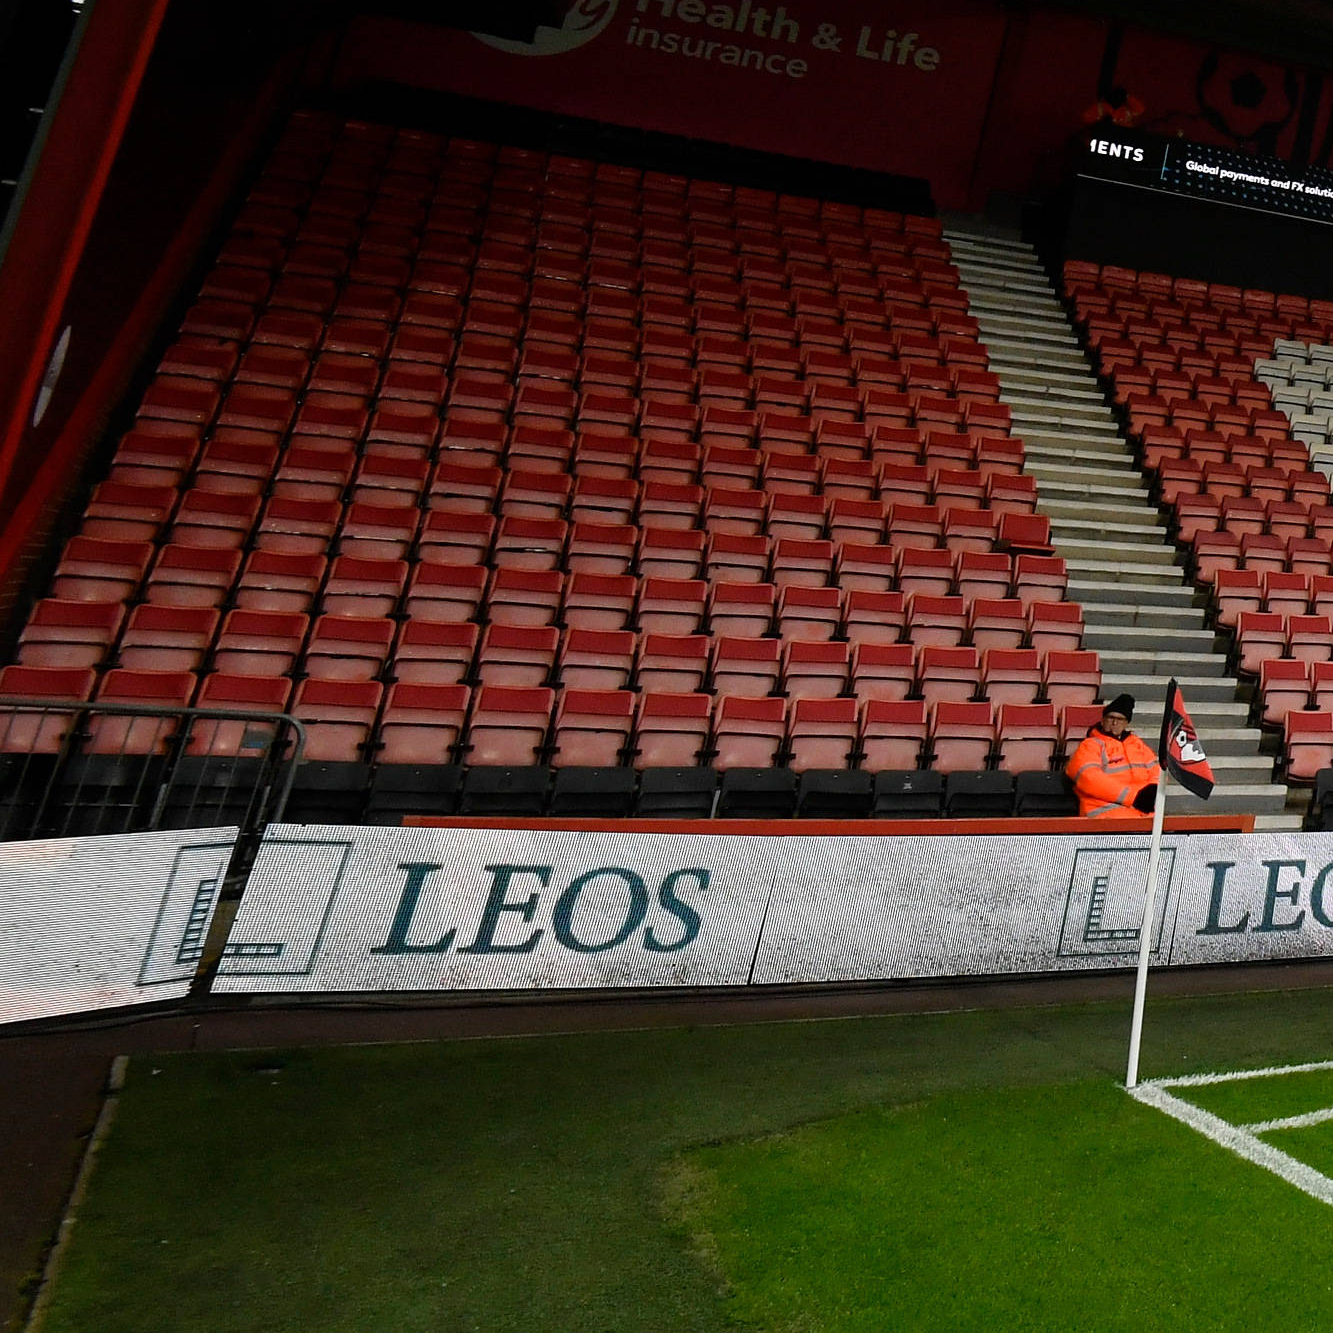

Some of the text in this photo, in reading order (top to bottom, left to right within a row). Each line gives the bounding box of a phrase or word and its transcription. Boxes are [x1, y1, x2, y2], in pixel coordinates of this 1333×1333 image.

[626, 17, 808, 79] insurance
[812, 23, 844, 53] &
[855, 25, 942, 71] Life
[1185, 160, 1219, 177] Global
[1220, 167, 1270, 187] payments
[1271, 178, 1290, 189] and
[1291, 180, 1304, 192] FX
[370, 860, 712, 956] LEOS
